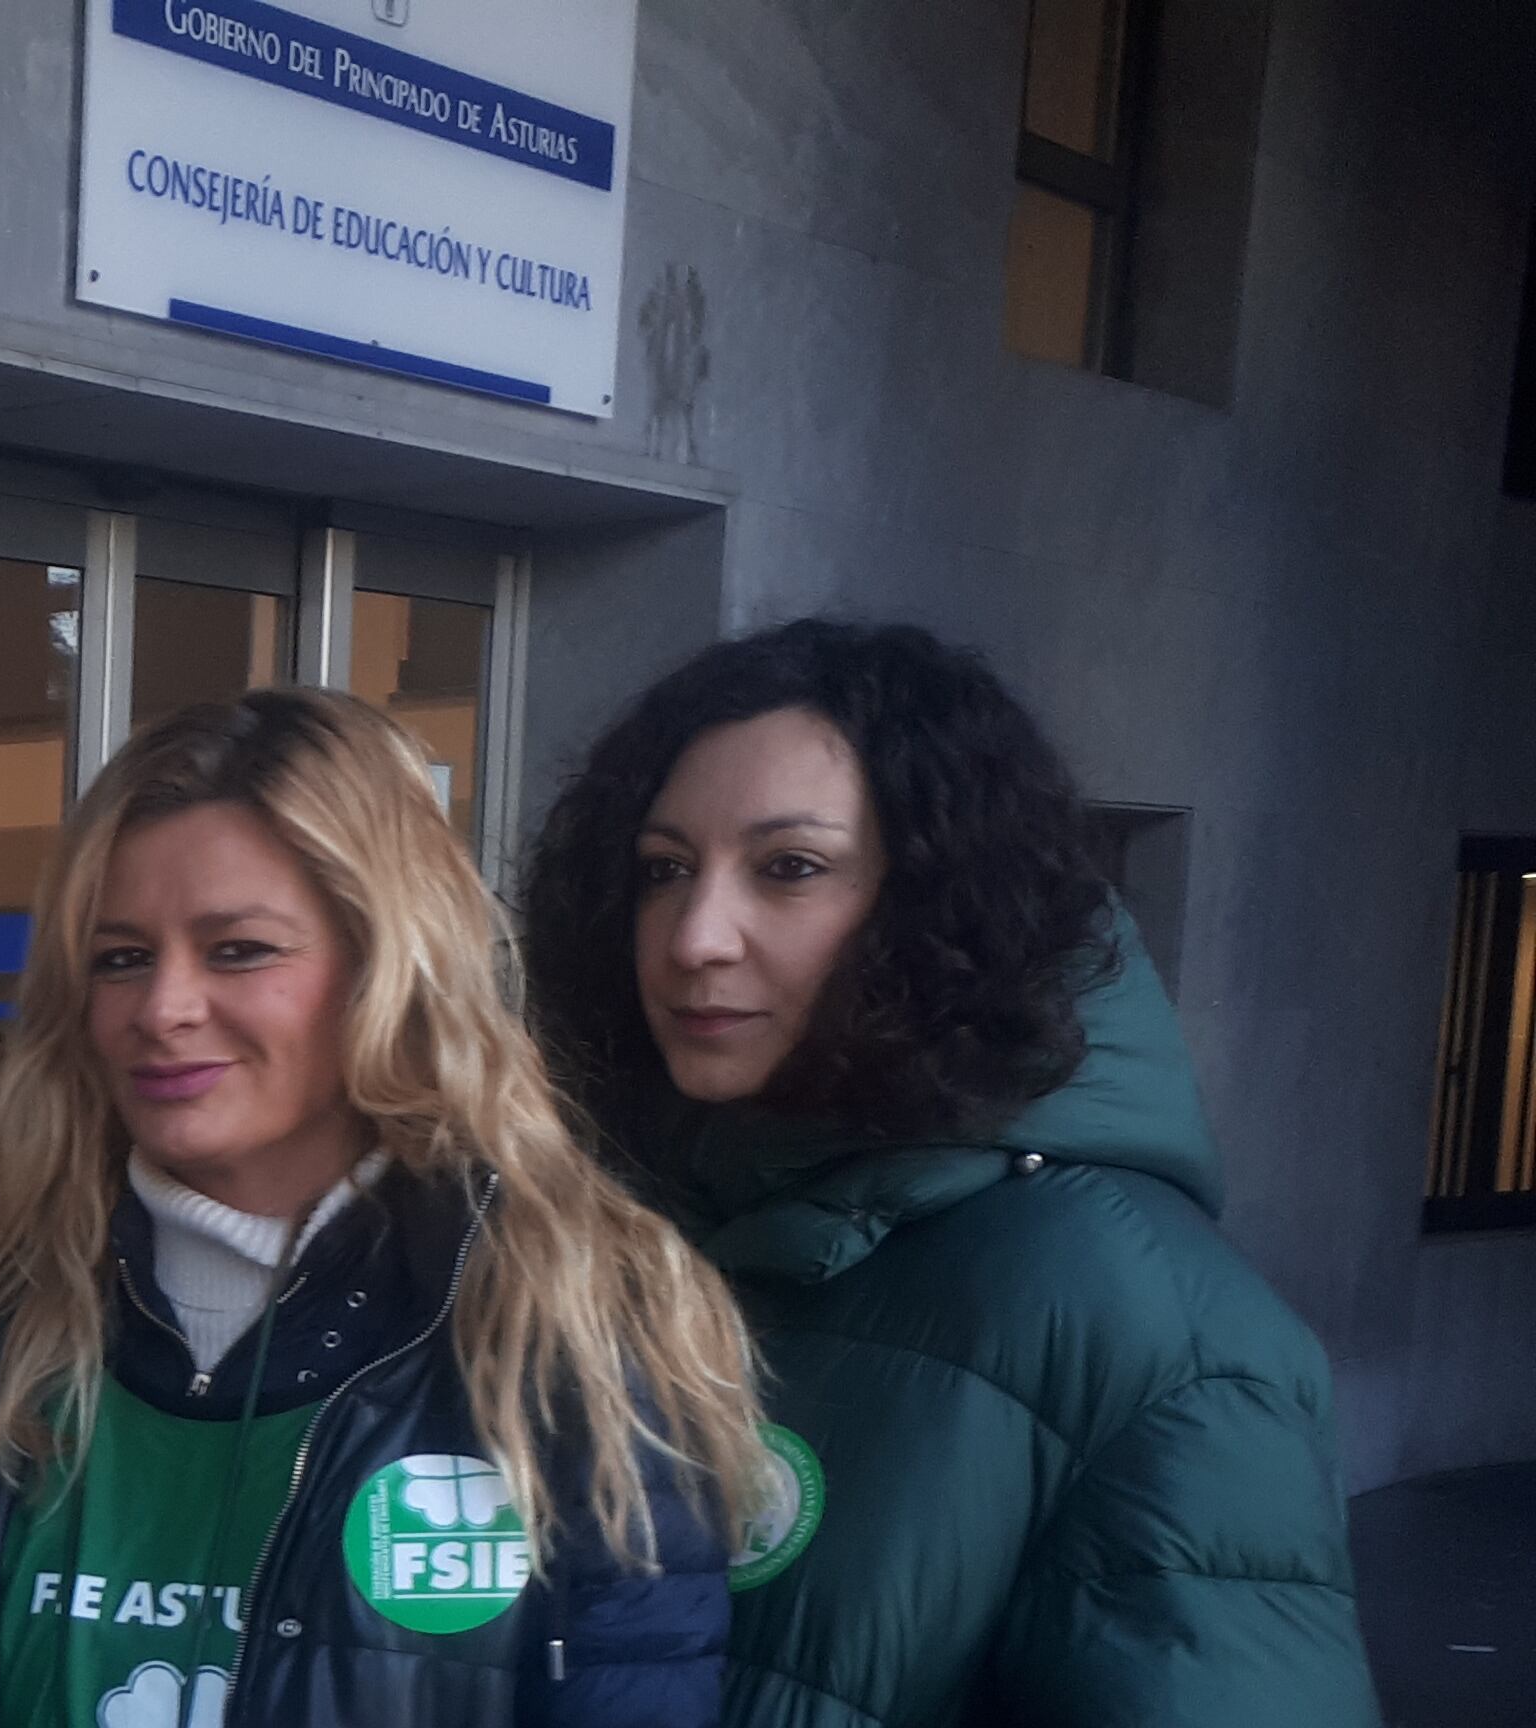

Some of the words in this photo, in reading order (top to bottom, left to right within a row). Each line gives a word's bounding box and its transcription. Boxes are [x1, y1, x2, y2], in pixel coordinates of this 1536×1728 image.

[288, 40, 324, 80] DEL
[333, 48, 450, 123] PRINCIPADO
[458, 101, 482, 133] DE
[489, 103, 578, 165] ASTURIAS
[127, 149, 285, 231] CONSEJERÍA
[293, 197, 325, 240] DE
[333, 207, 472, 280] EDUCACIÓN
[477, 247, 492, 285] Y
[496, 253, 592, 311] CULTURA
[391, 1541, 531, 1590] FSIE
